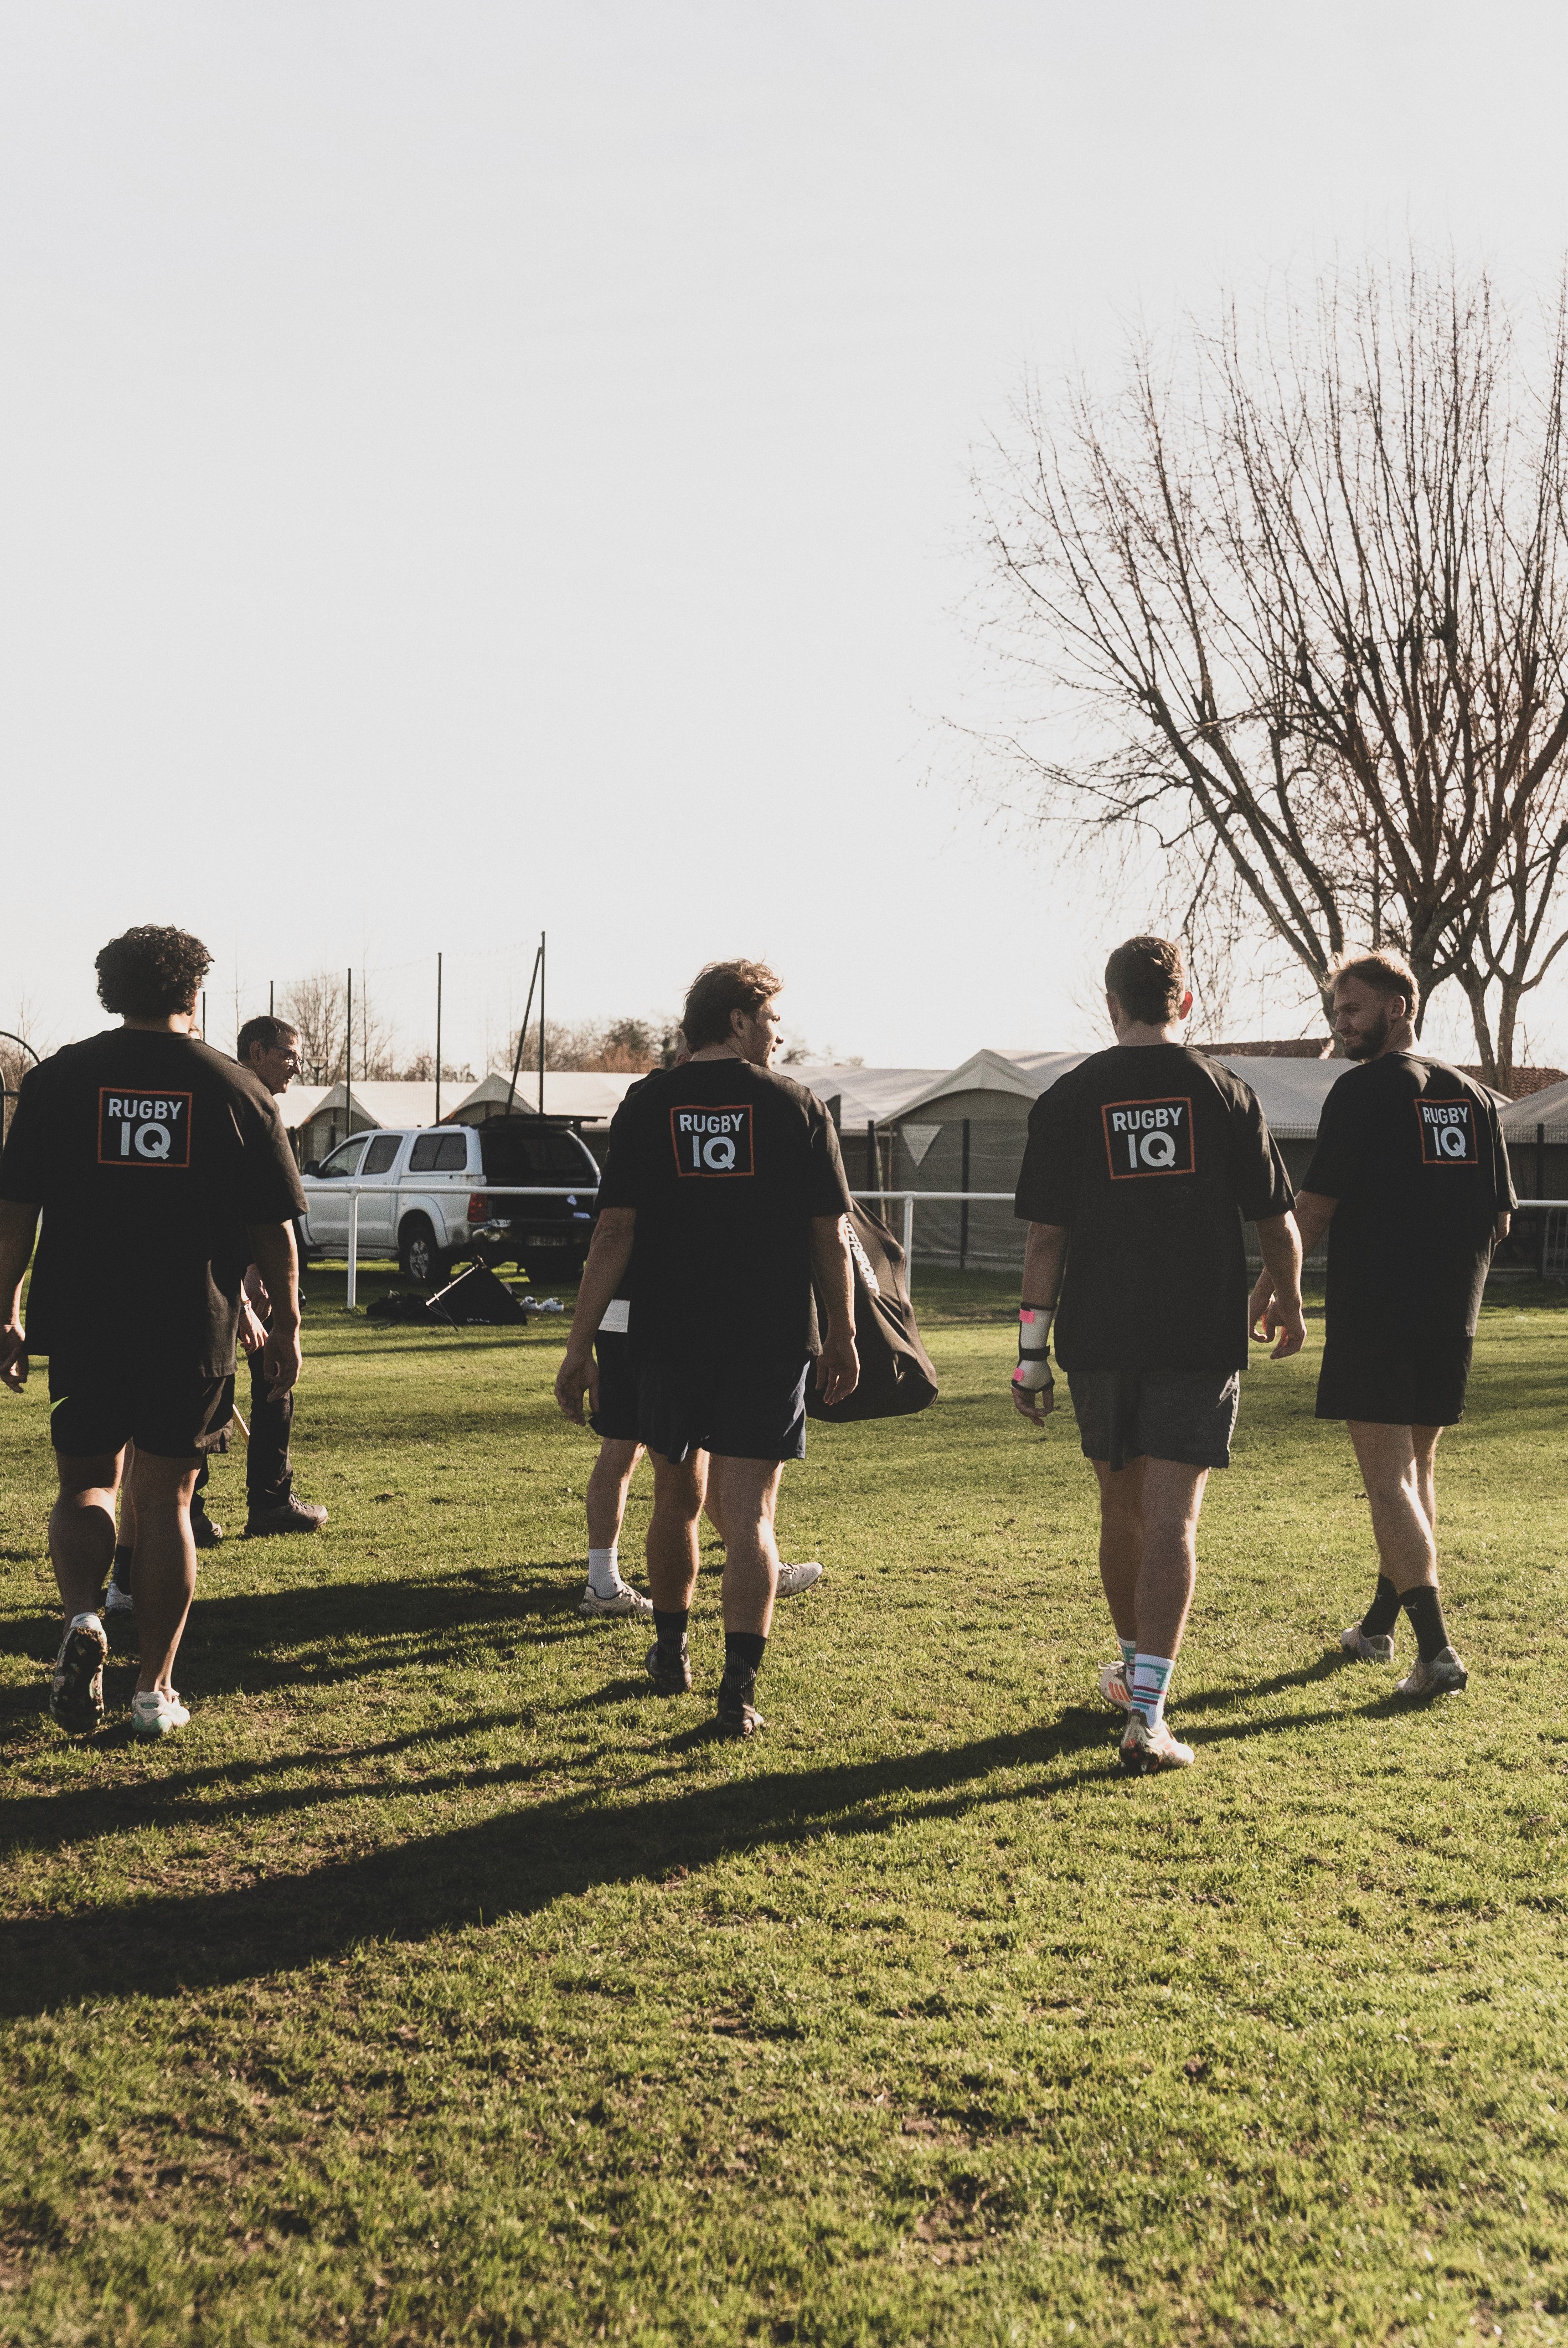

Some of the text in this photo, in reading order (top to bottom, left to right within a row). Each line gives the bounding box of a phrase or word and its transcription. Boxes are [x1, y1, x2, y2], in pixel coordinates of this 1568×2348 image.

[109, 1098, 183, 1120] RUGBY
[1112, 1107, 1183, 1131] RUGBY
[1422, 1106, 1468, 1124] RUGBY
[679, 1113, 744, 1134] RUGBY
[121, 1121, 171, 1160] IQ
[693, 1135, 736, 1170] IQ
[1128, 1131, 1176, 1168] IQ
[1433, 1126, 1467, 1158] IQ
